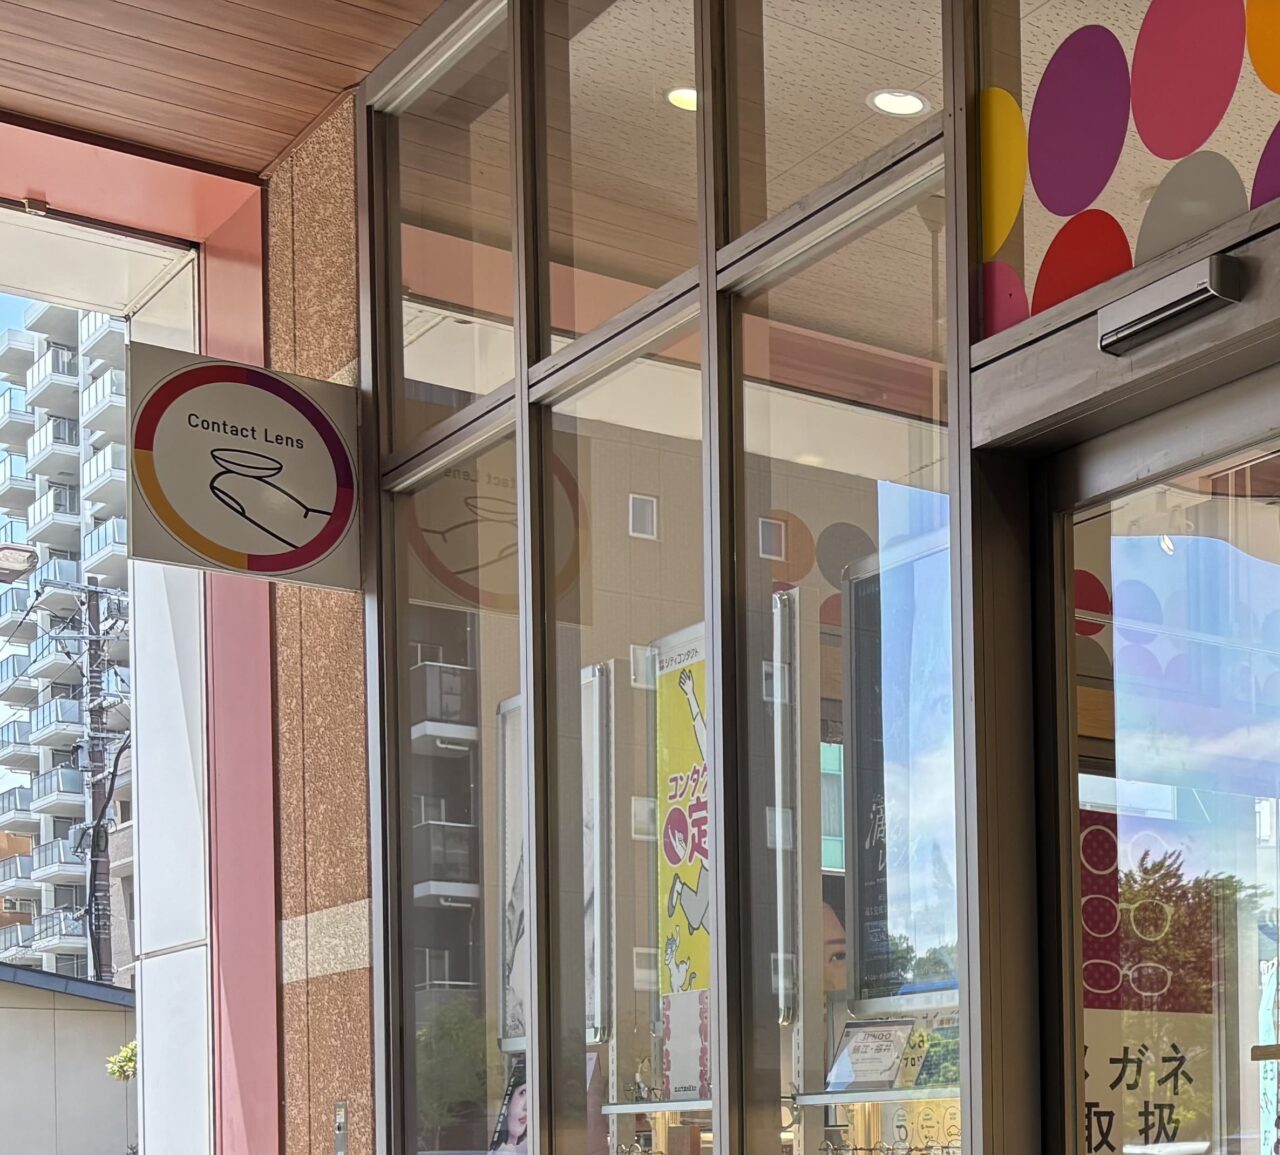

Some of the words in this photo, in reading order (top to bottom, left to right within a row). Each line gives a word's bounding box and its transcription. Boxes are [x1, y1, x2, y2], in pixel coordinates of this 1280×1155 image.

[187, 413, 257, 440] Contact
[264, 428, 304, 449] Lens
[1085, 1043, 1194, 1096] ガネ
[1085, 1100, 1181, 1154] 取扱
